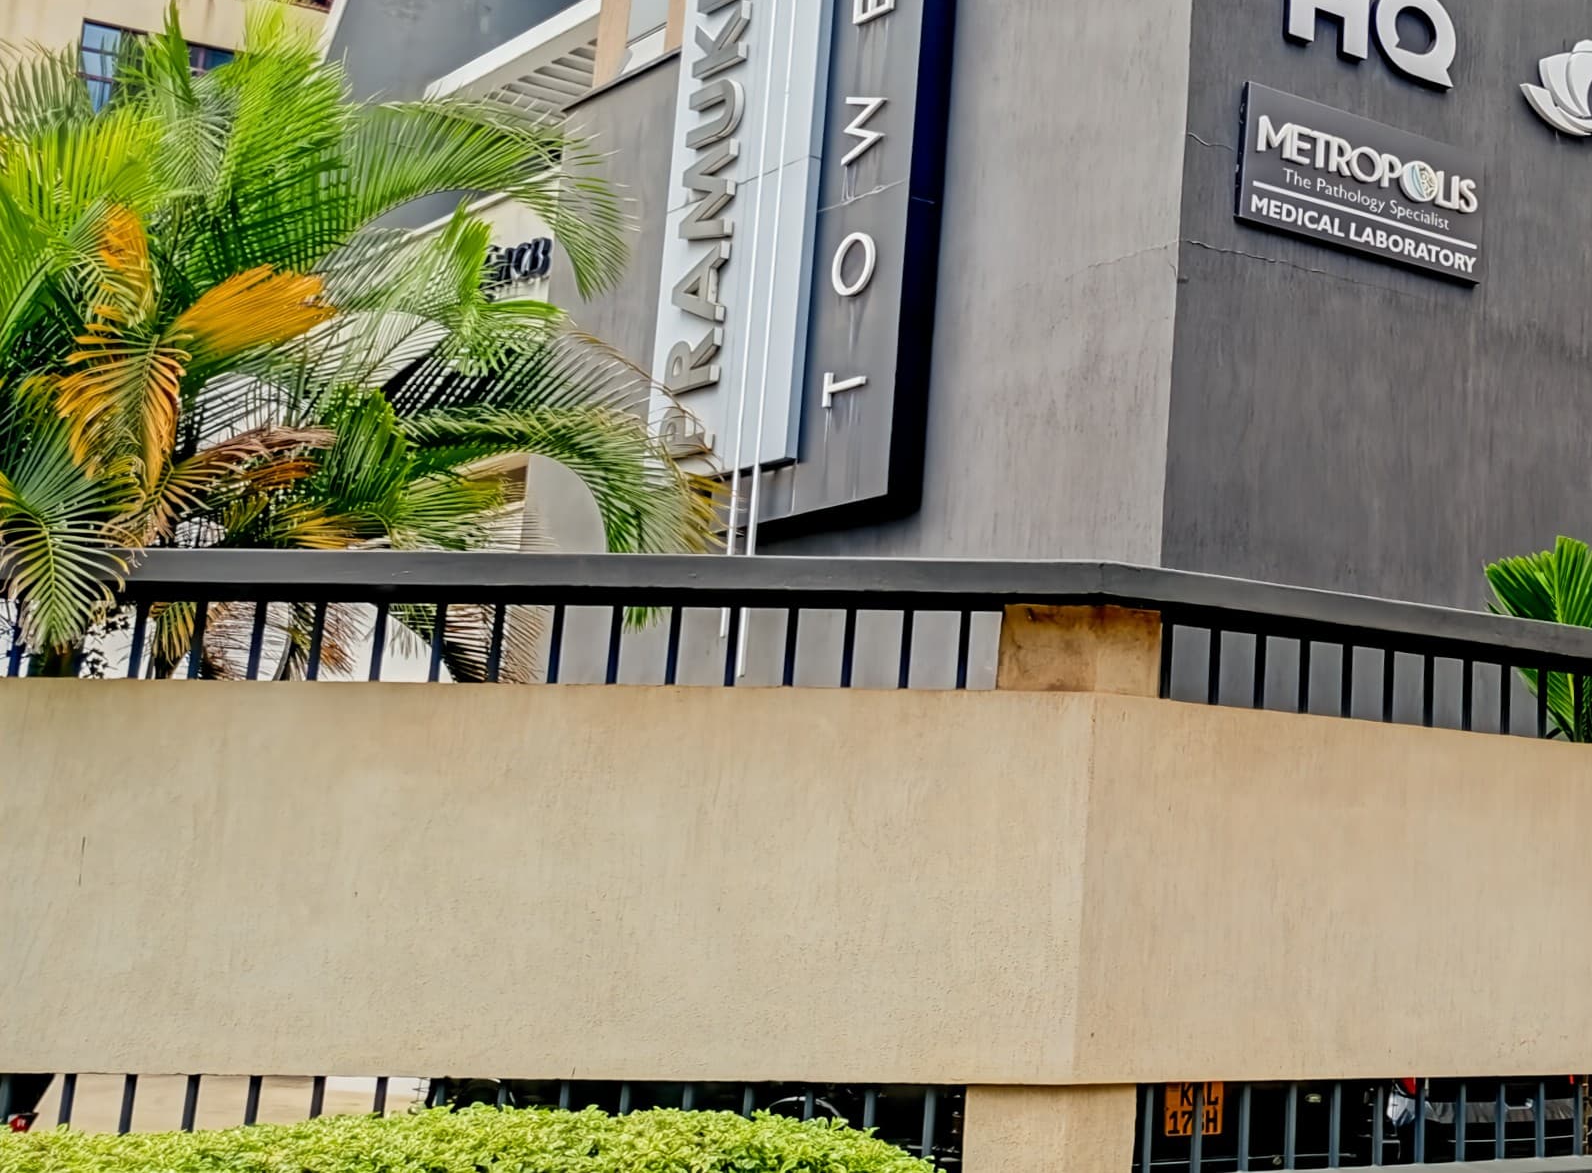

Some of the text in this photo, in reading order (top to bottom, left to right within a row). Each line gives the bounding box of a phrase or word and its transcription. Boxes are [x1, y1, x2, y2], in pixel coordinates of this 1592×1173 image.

[1256, 114, 1479, 214] METROPOLIS
[1282, 167, 1450, 231] The Pathology Specialist
[1250, 193, 1477, 274] MEDICAL LABORATORY
[1168, 1109, 1219, 1134] 17H
[1181, 1082, 1219, 1107] KL
